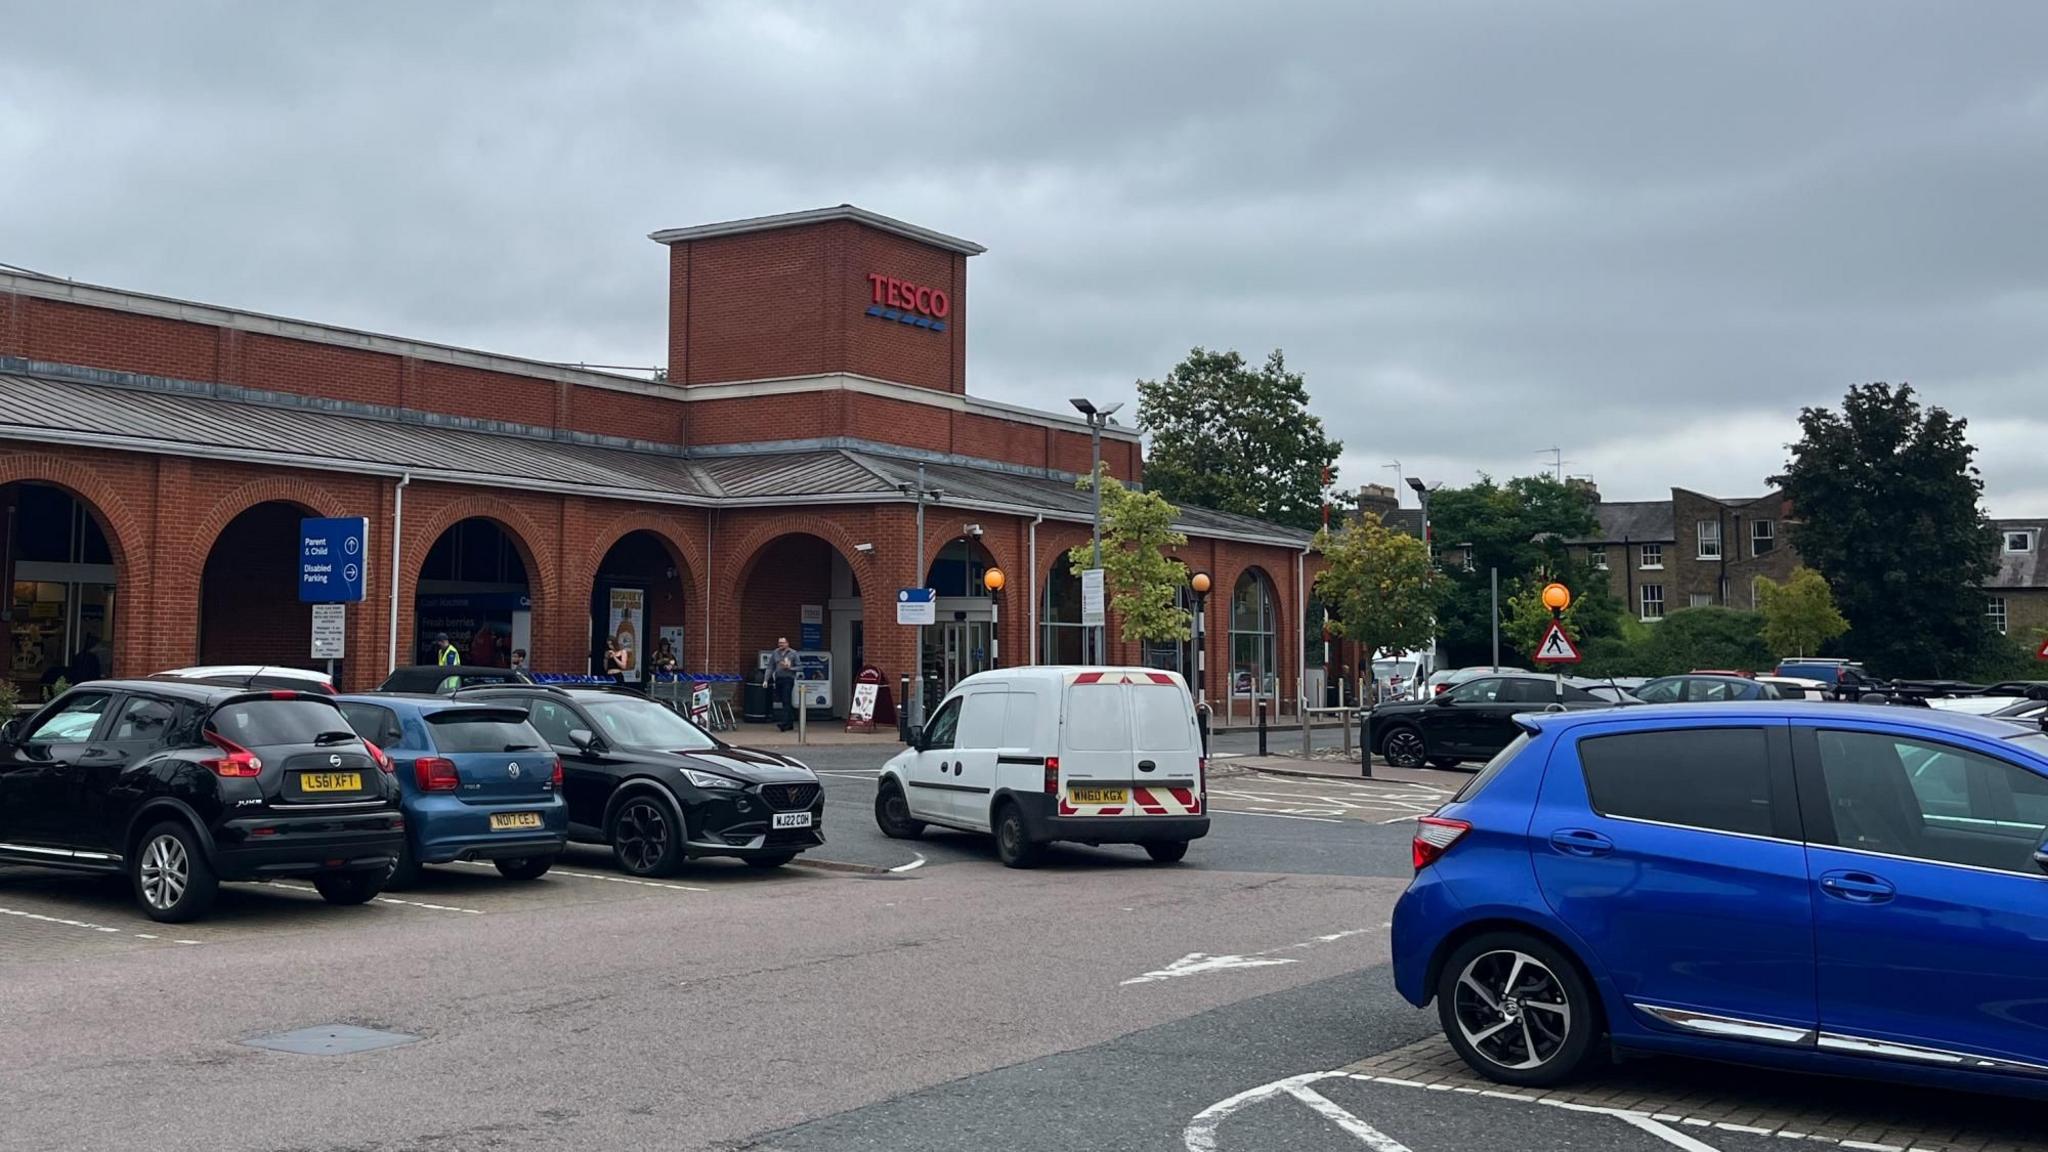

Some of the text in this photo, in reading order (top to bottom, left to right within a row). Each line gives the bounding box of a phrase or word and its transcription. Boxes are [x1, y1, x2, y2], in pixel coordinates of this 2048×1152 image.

[867, 273, 949, 318] TESCO
[304, 538, 327, 547] Parent
[304, 547, 328, 556] & Child
[304, 564, 332, 573] Disabled
[303, 574, 328, 584] Parking
[308, 774, 354, 789] LS61 XFT
[1103, 789, 1123, 801] KGX
